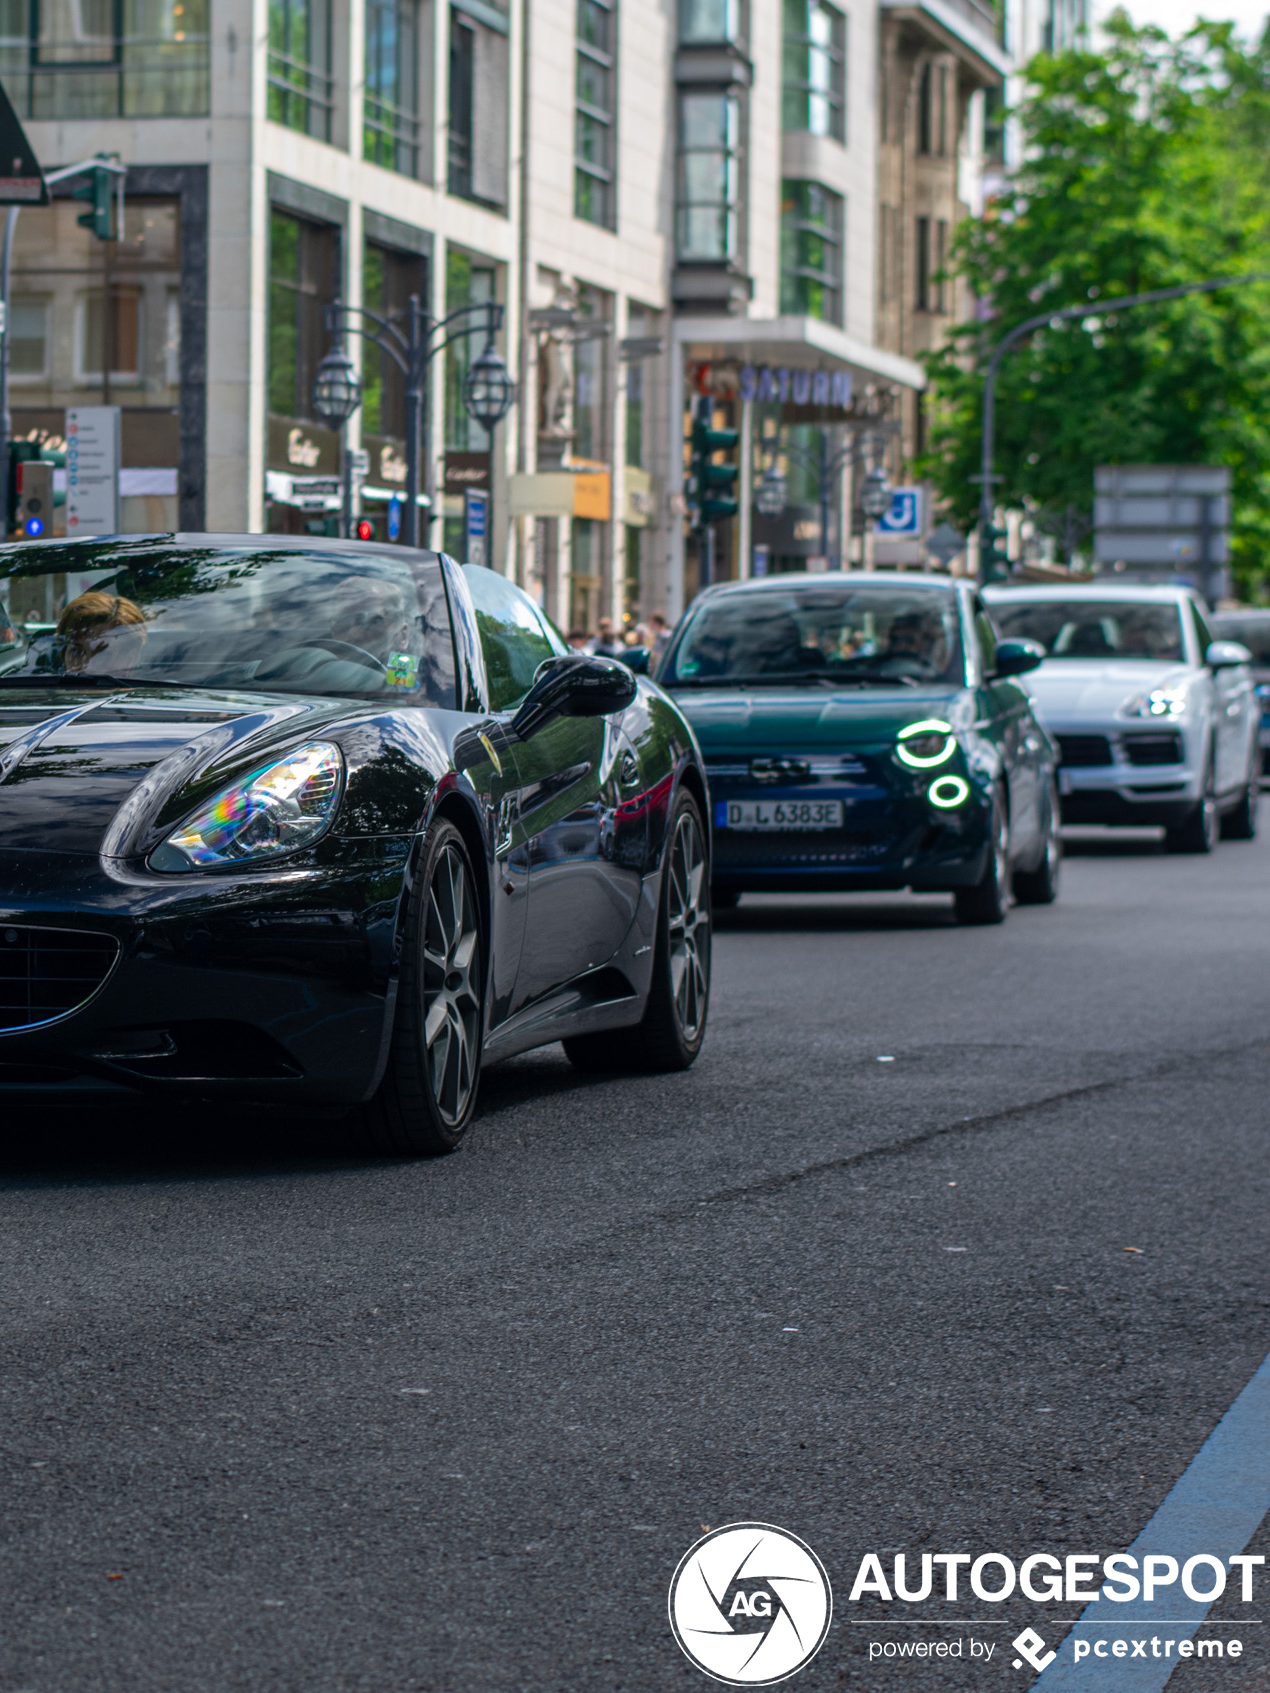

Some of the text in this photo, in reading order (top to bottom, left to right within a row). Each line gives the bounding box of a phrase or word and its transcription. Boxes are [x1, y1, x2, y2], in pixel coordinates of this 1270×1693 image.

[740, 367, 852, 405] SATURN
[729, 804, 741, 824] D
[755, 804, 769, 824] L
